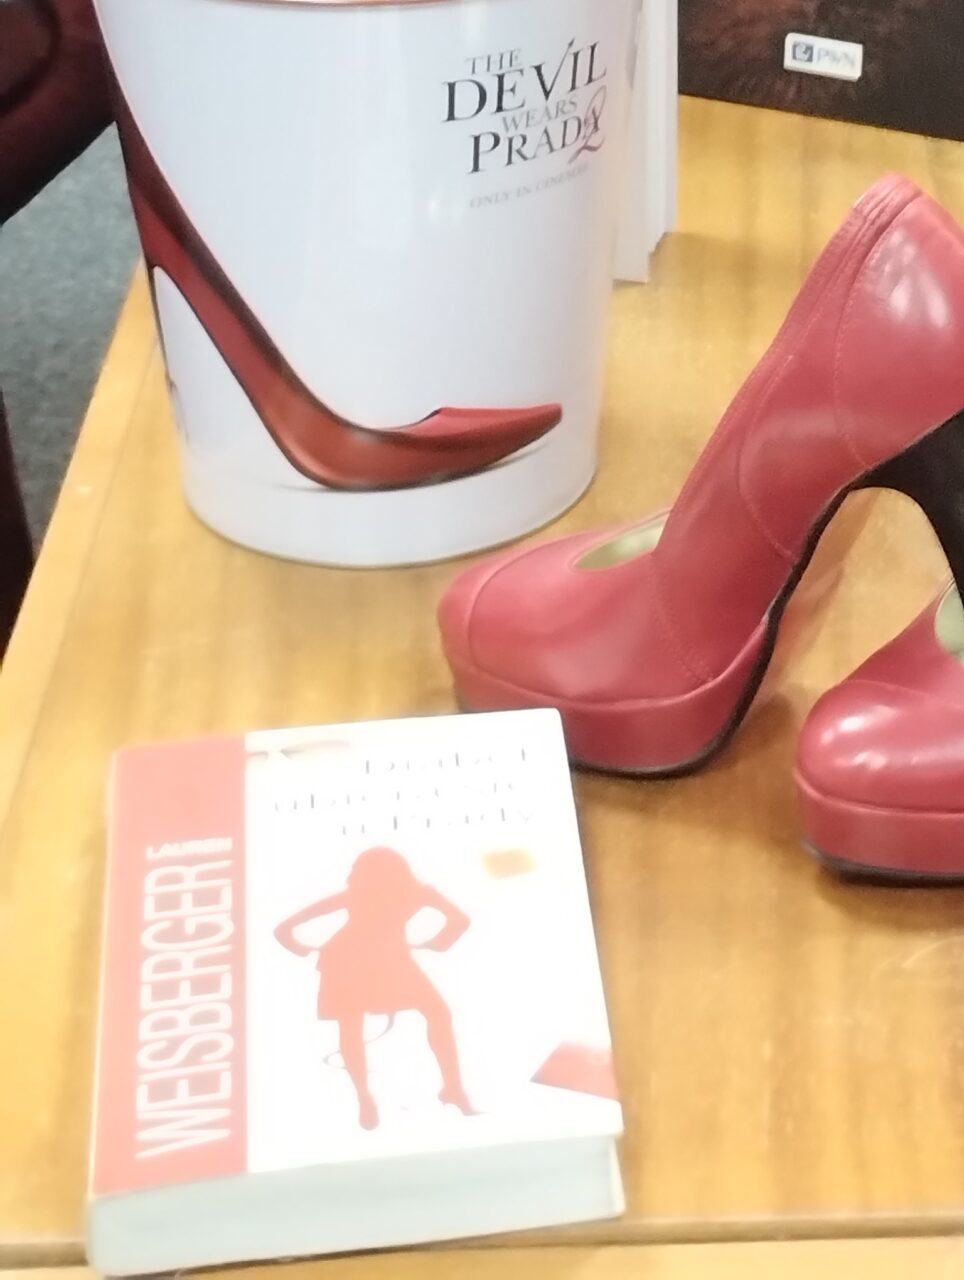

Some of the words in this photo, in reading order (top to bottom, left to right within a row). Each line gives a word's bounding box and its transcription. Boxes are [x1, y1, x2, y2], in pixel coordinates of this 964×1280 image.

[441, 38, 608, 123] DEVIL
[465, 48, 523, 76] THE
[501, 96, 580, 134] WEARS
[135, 859, 235, 1160] WEISBERGER
